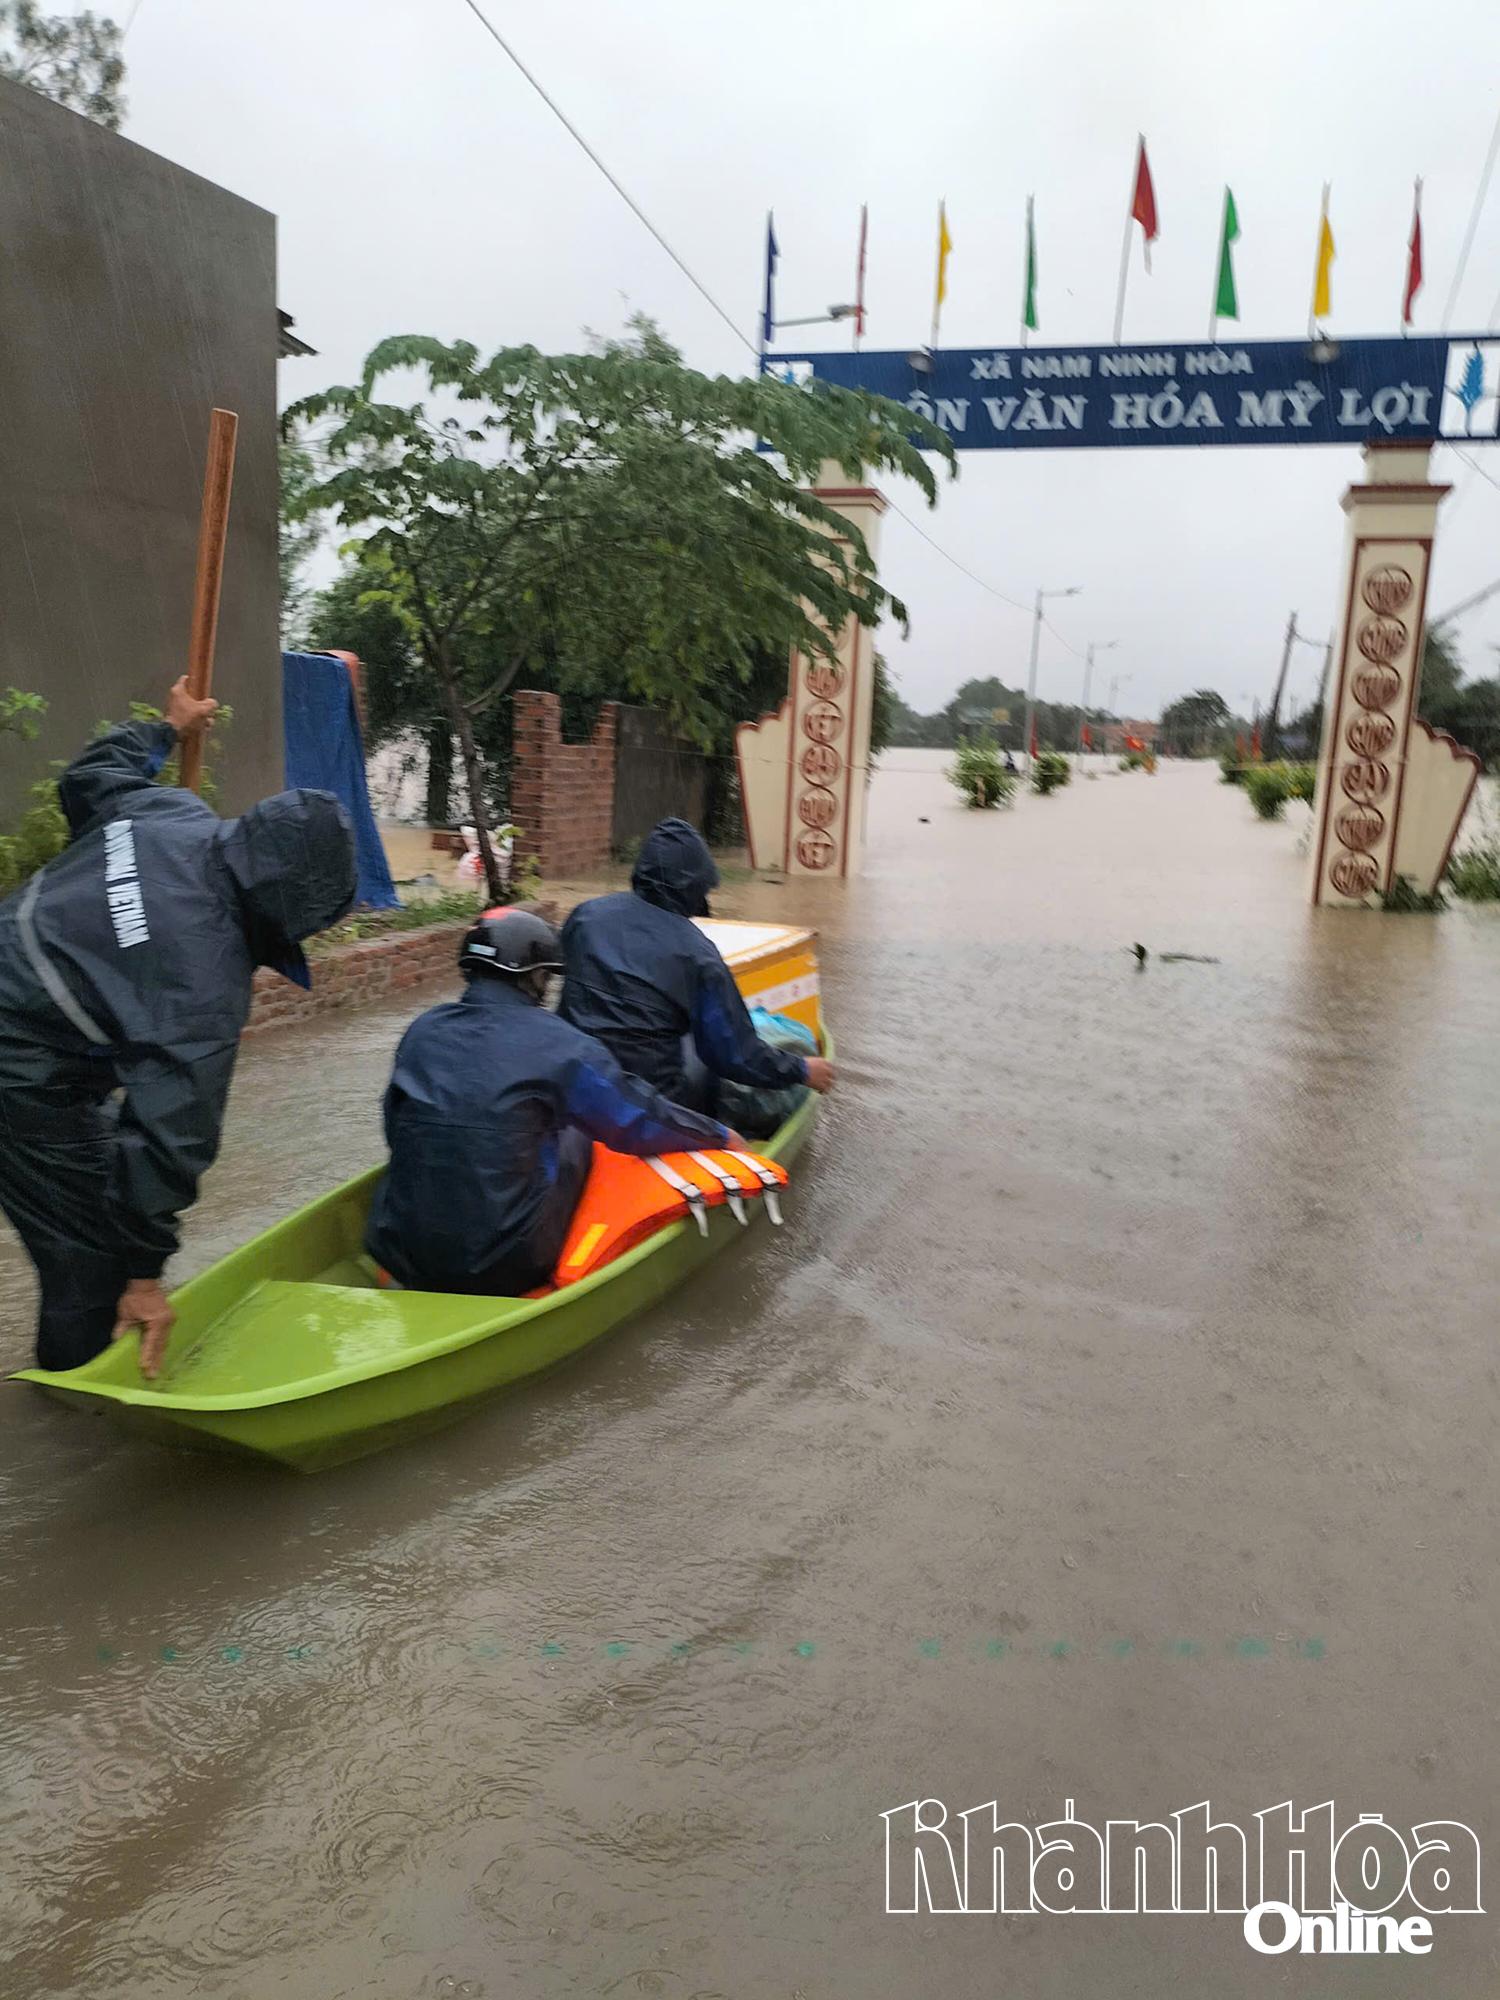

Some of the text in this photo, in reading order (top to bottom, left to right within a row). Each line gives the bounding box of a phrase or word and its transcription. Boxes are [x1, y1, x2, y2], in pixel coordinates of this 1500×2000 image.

[969, 346, 1254, 380] XÃ NAM NINH HÒA
[981, 387, 1089, 431] VĂN
[1108, 379, 1225, 429] HÓA
[1235, 380, 1325, 428] MỸ
[1336, 380, 1433, 435] LỢI
[106, 881, 151, 948] VIETNAM
